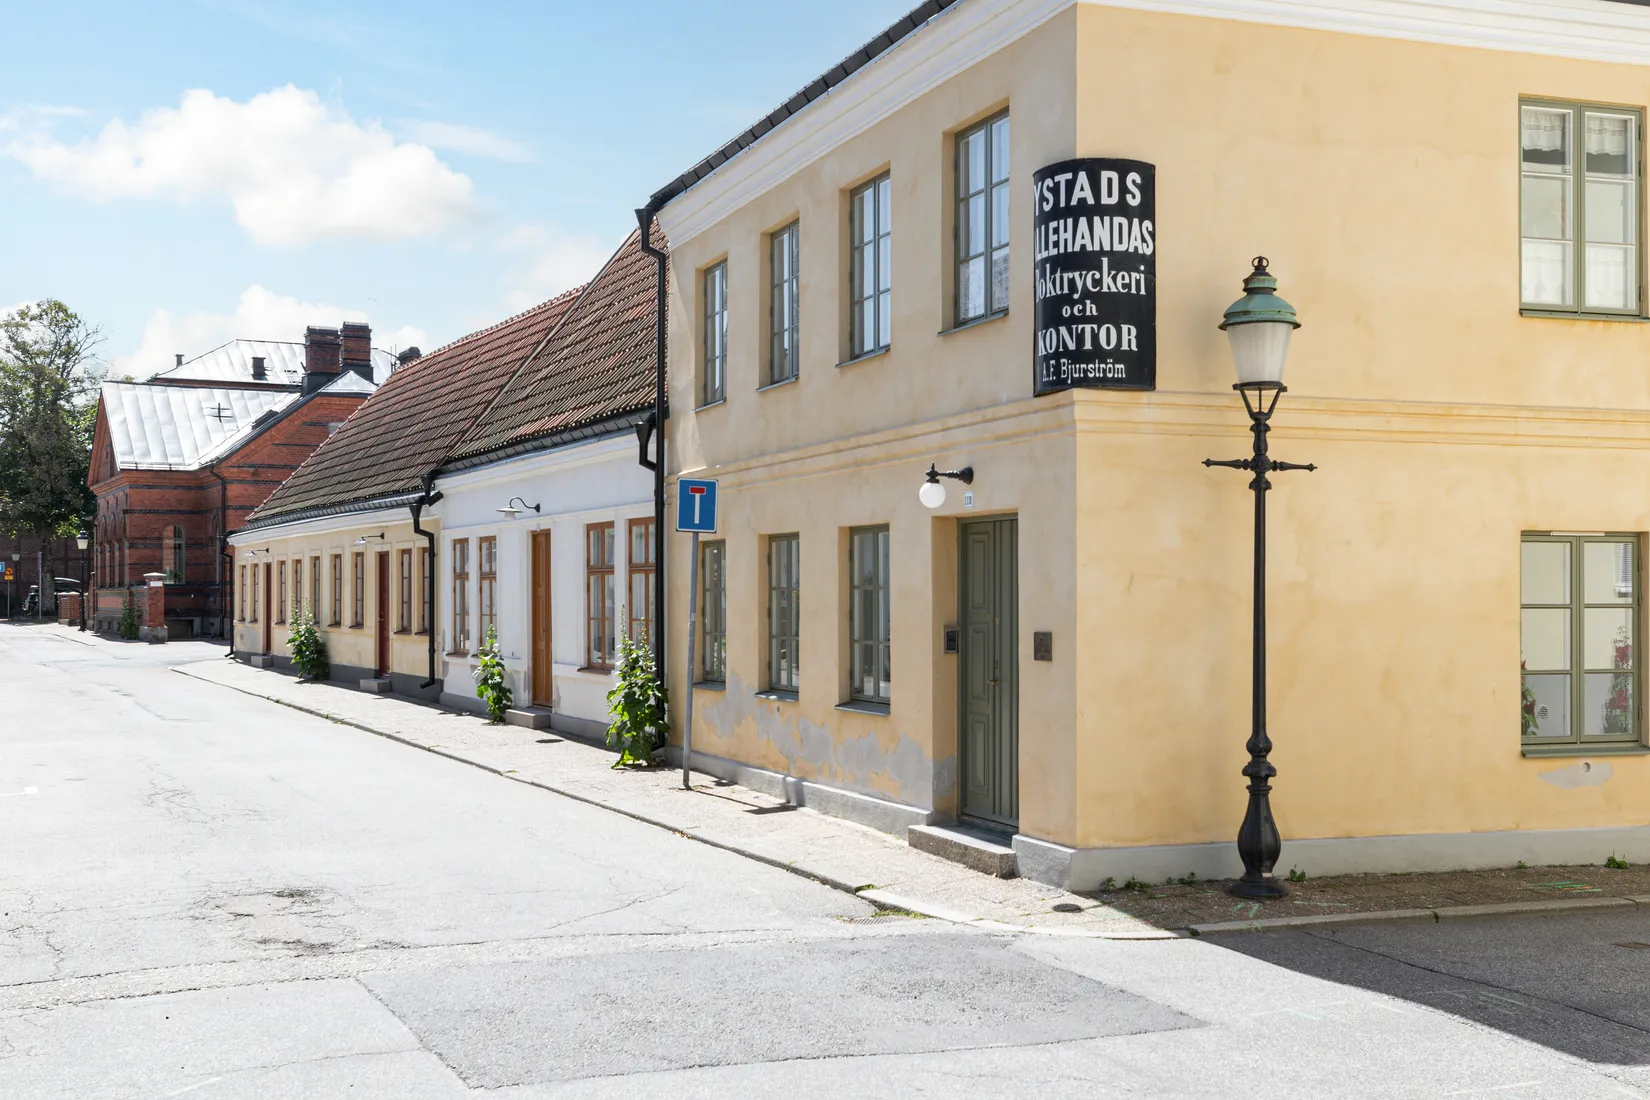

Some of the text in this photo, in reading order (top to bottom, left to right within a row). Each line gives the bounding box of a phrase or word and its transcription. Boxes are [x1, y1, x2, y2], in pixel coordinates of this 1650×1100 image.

[1034, 170, 1141, 216] YSTADS
[1035, 216, 1153, 262] LLEHANDAS
[1062, 300, 1098, 317] och
[1038, 324, 1138, 356] KONTOR
[1060, 359, 1126, 384] Bjurström
